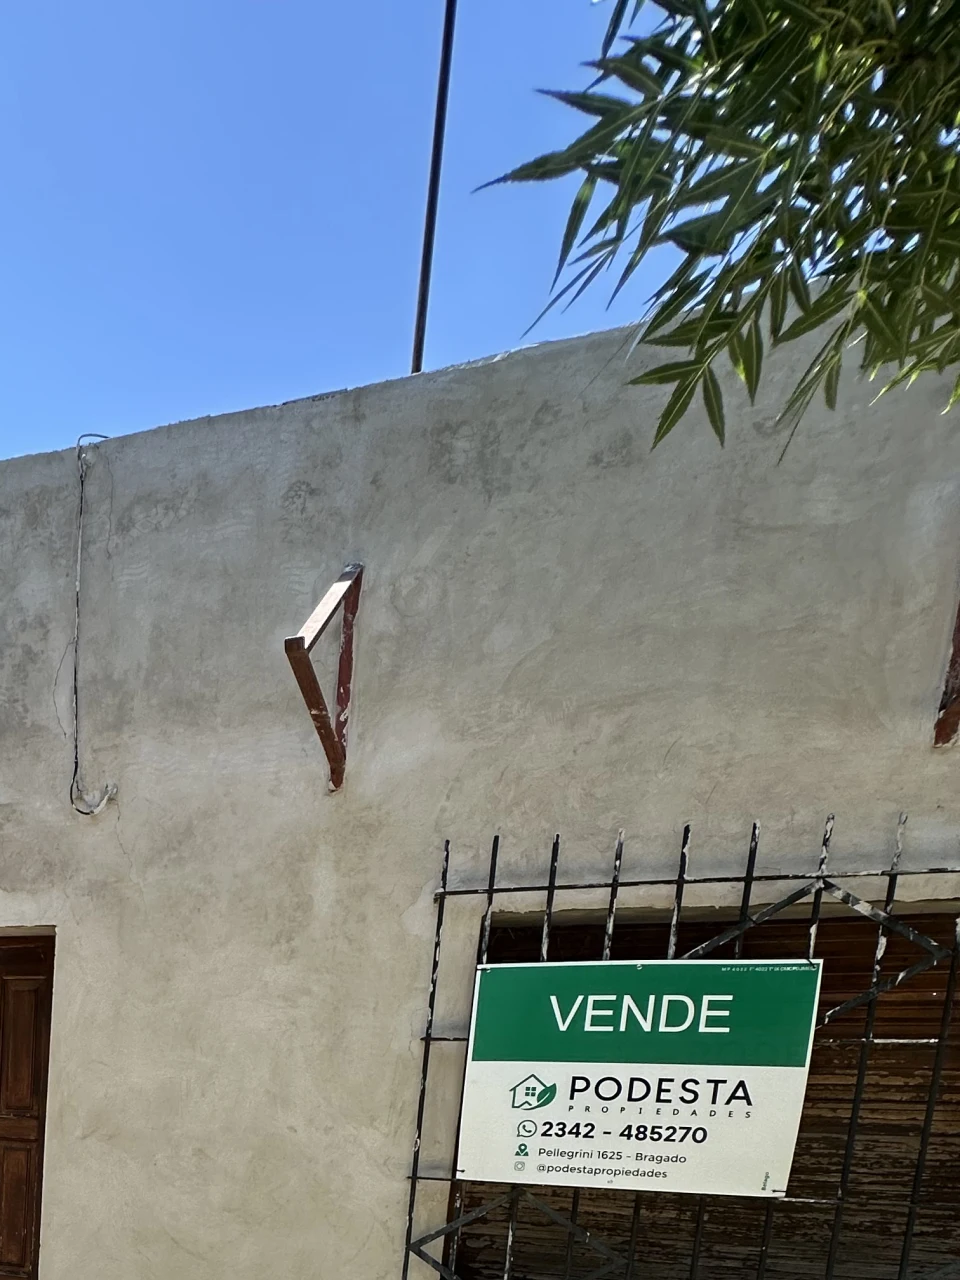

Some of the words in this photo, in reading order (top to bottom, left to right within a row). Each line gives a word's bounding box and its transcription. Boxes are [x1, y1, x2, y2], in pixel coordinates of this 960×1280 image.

[549, 994, 734, 1033] VENDE
[569, 1075, 753, 1106] PODESTA
[568, 1105, 752, 1118] PROPIEDADES
[540, 1121, 596, 1139] 2342
[619, 1124, 708, 1144] 485270
[538, 1147, 593, 1160] Pellegrini
[597, 1150, 623, 1160] 1625
[635, 1152, 687, 1164] Bragado
[536, 1163, 668, 1179] @podestapropiedades
